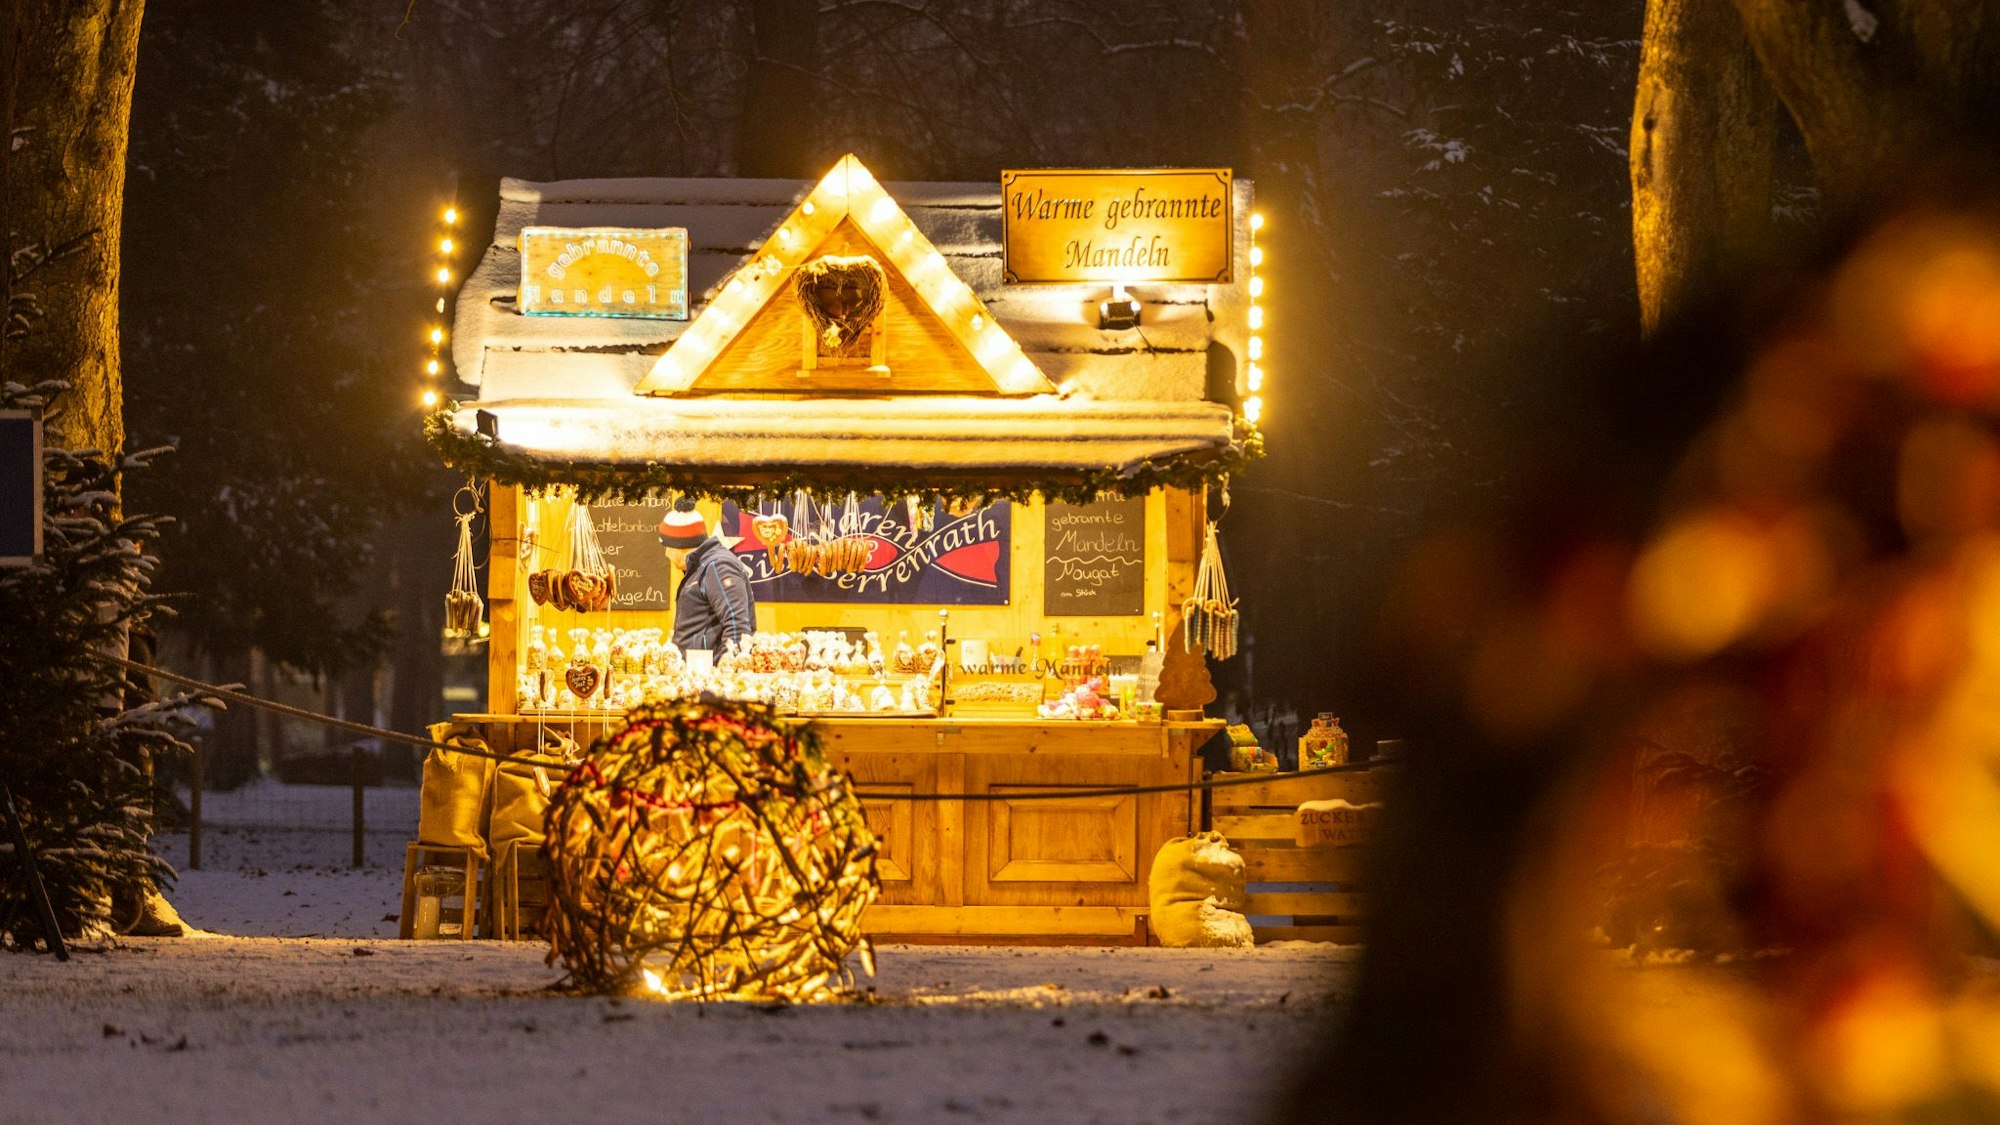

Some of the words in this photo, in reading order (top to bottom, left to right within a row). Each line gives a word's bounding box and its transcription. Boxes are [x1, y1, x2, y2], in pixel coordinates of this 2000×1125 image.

[1011, 188, 1094, 220] Warme
[1104, 187, 1221, 230] gebrannte
[547, 239, 659, 280] gebrannte
[1064, 235, 1170, 269] Mandeln
[526, 284, 684, 304] Mandeln
[1051, 510, 1125, 532] gebrannte
[1056, 530, 1141, 553] Mandeln
[1055, 562, 1120, 587] Nougat
[960, 660, 1028, 676] warme
[1035, 657, 1123, 681] Mandeln
